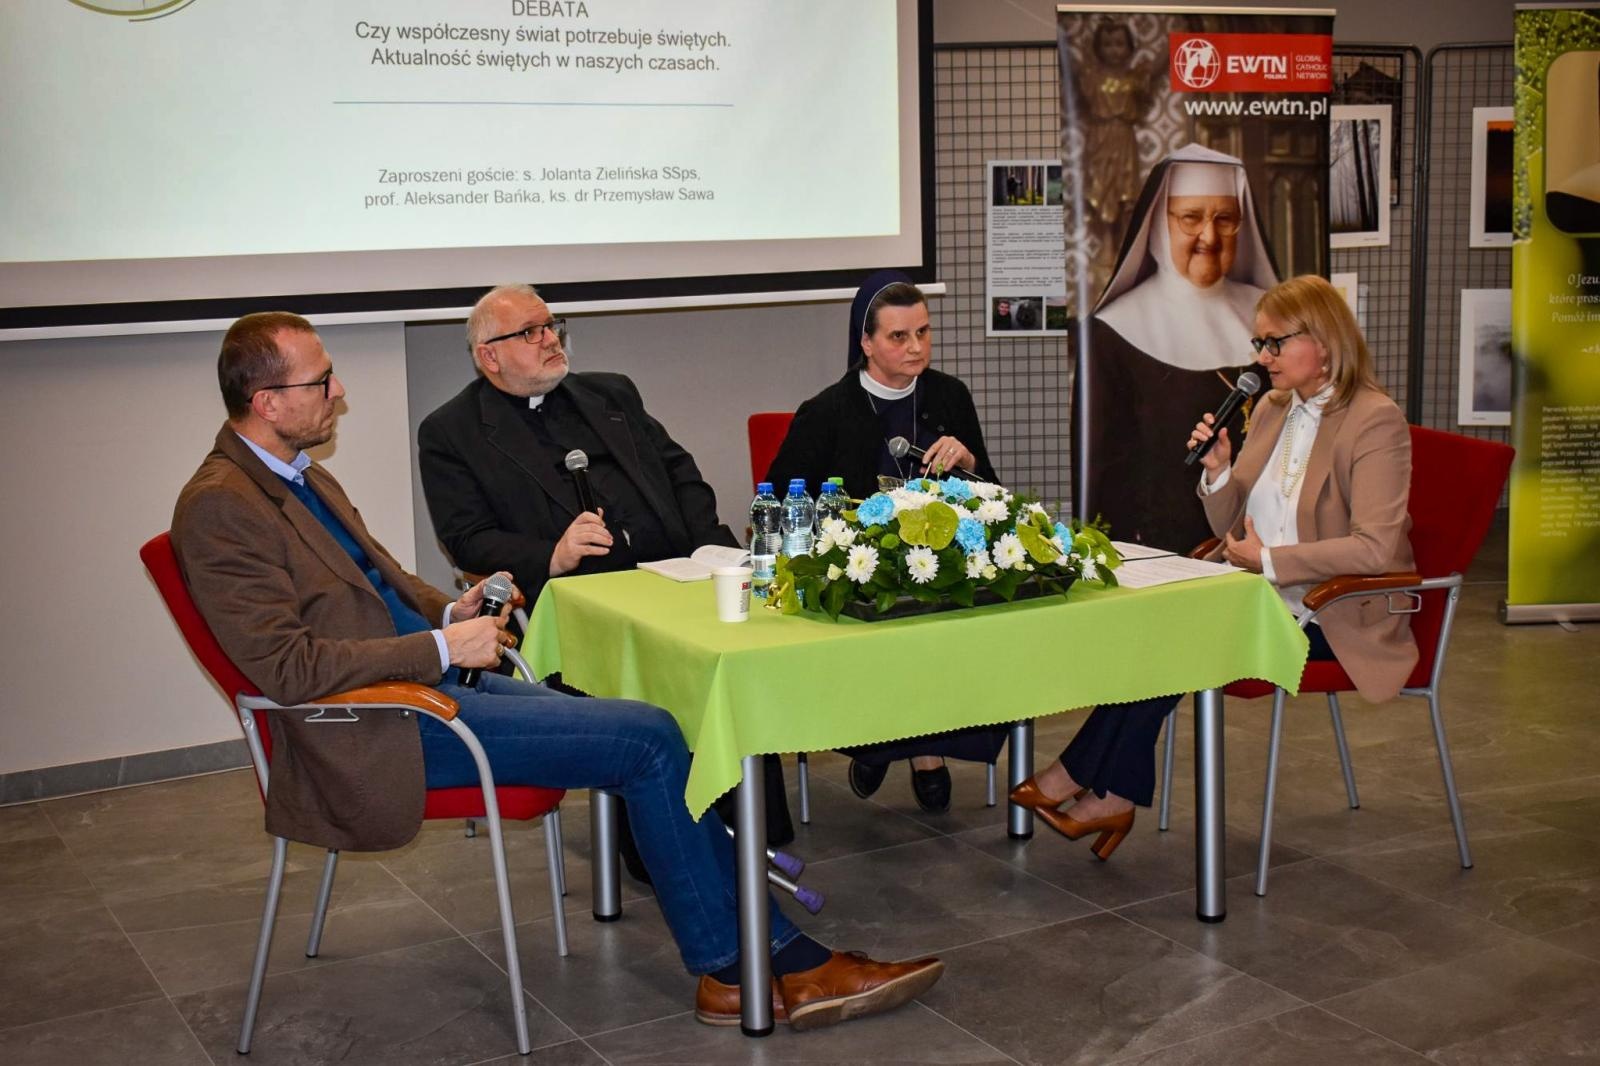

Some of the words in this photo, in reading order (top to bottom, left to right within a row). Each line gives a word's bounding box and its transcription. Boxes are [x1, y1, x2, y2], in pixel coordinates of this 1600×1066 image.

[511, 0, 590, 18] DEBATA
[355, 21, 391, 44] Czy
[396, 23, 511, 46] współczesny
[516, 25, 560, 42] świat
[565, 28, 653, 49] potrzebuje
[657, 29, 732, 51] świętych.
[371, 48, 472, 66] Aktualność
[476, 49, 551, 71] świętych
[556, 55, 570, 68] w
[575, 54, 644, 73] naszych
[648, 55, 720, 71] czasach.
[1227, 55, 1287, 74] EWTN
[1184, 97, 1328, 120] www.ewtn.pl
[378, 169, 462, 186] Zaproszeni
[467, 167, 519, 185] goście:
[523, 170, 536, 181] s.
[539, 168, 592, 181] Jolanta
[595, 166, 659, 181] Zielińska
[364, 192, 399, 209] prof.
[404, 191, 490, 206] Aleksander
[494, 189, 545, 204] Bańka,
[550, 189, 569, 202] ks.
[574, 189, 590, 202] dr
[593, 188, 675, 204] Przemysław
[678, 187, 715, 201] Sawa
[1567, 273, 1576, 286] O
